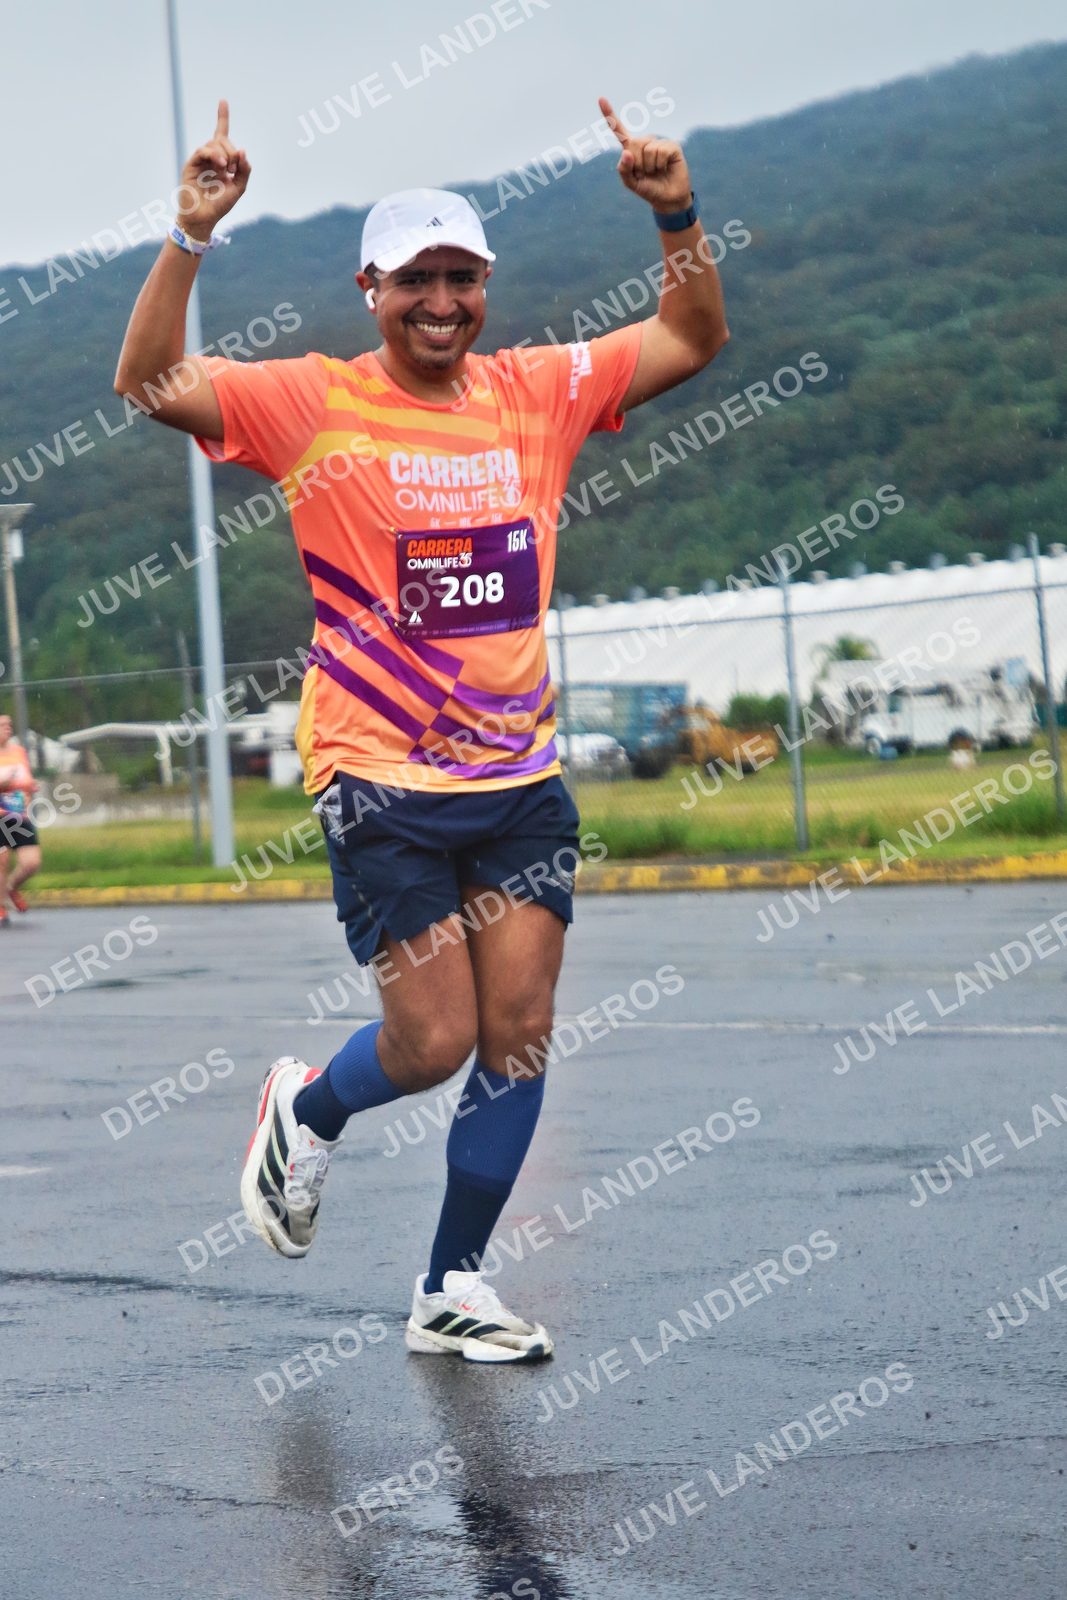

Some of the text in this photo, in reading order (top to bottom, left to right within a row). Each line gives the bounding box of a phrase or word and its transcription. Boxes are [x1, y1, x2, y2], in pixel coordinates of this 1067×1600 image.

[390, 448, 519, 487] CARRERA
[395, 485, 499, 512] OMNILIFE
[407, 537, 473, 557] CARRERA
[507, 529, 528, 553] 15K
[407, 556, 458, 570] OMNILIFE
[440, 572, 504, 607] 208
